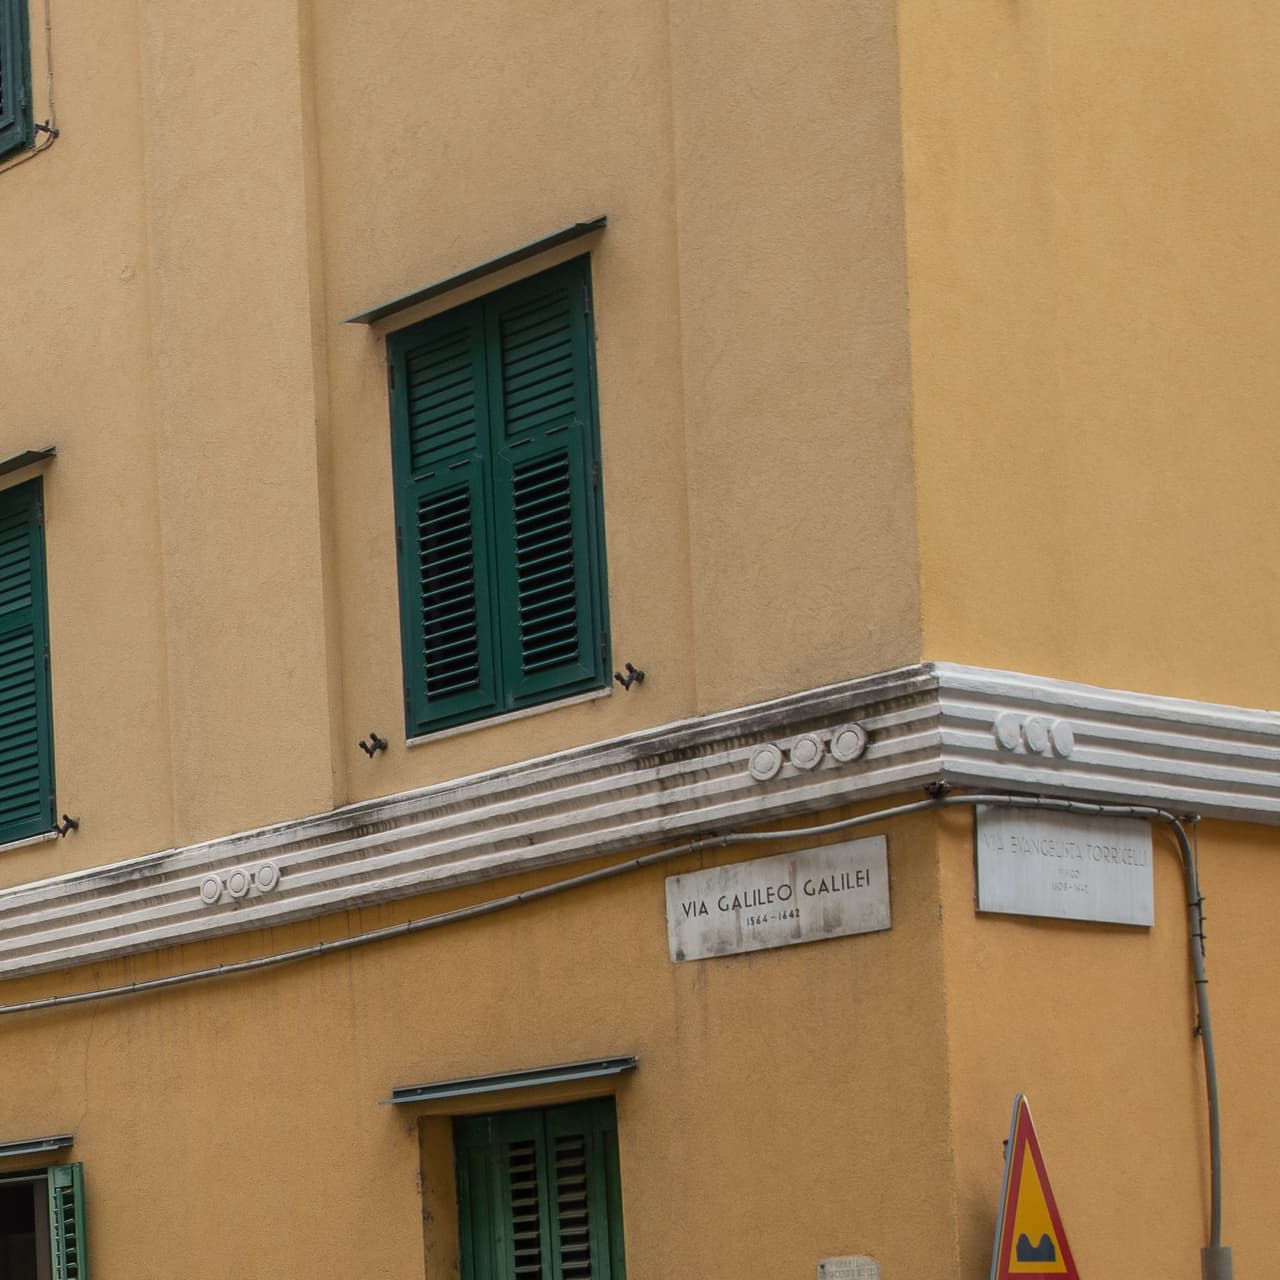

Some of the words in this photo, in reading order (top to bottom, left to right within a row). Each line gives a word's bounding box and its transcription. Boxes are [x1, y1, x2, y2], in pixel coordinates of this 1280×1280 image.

[983, 832, 1004, 851] VIA
[1011, 835, 1083, 860] EVANGELISTA
[682, 901, 709, 918] VIA
[717, 884, 792, 912] GALILEO
[803, 869, 870, 896] GALILEI
